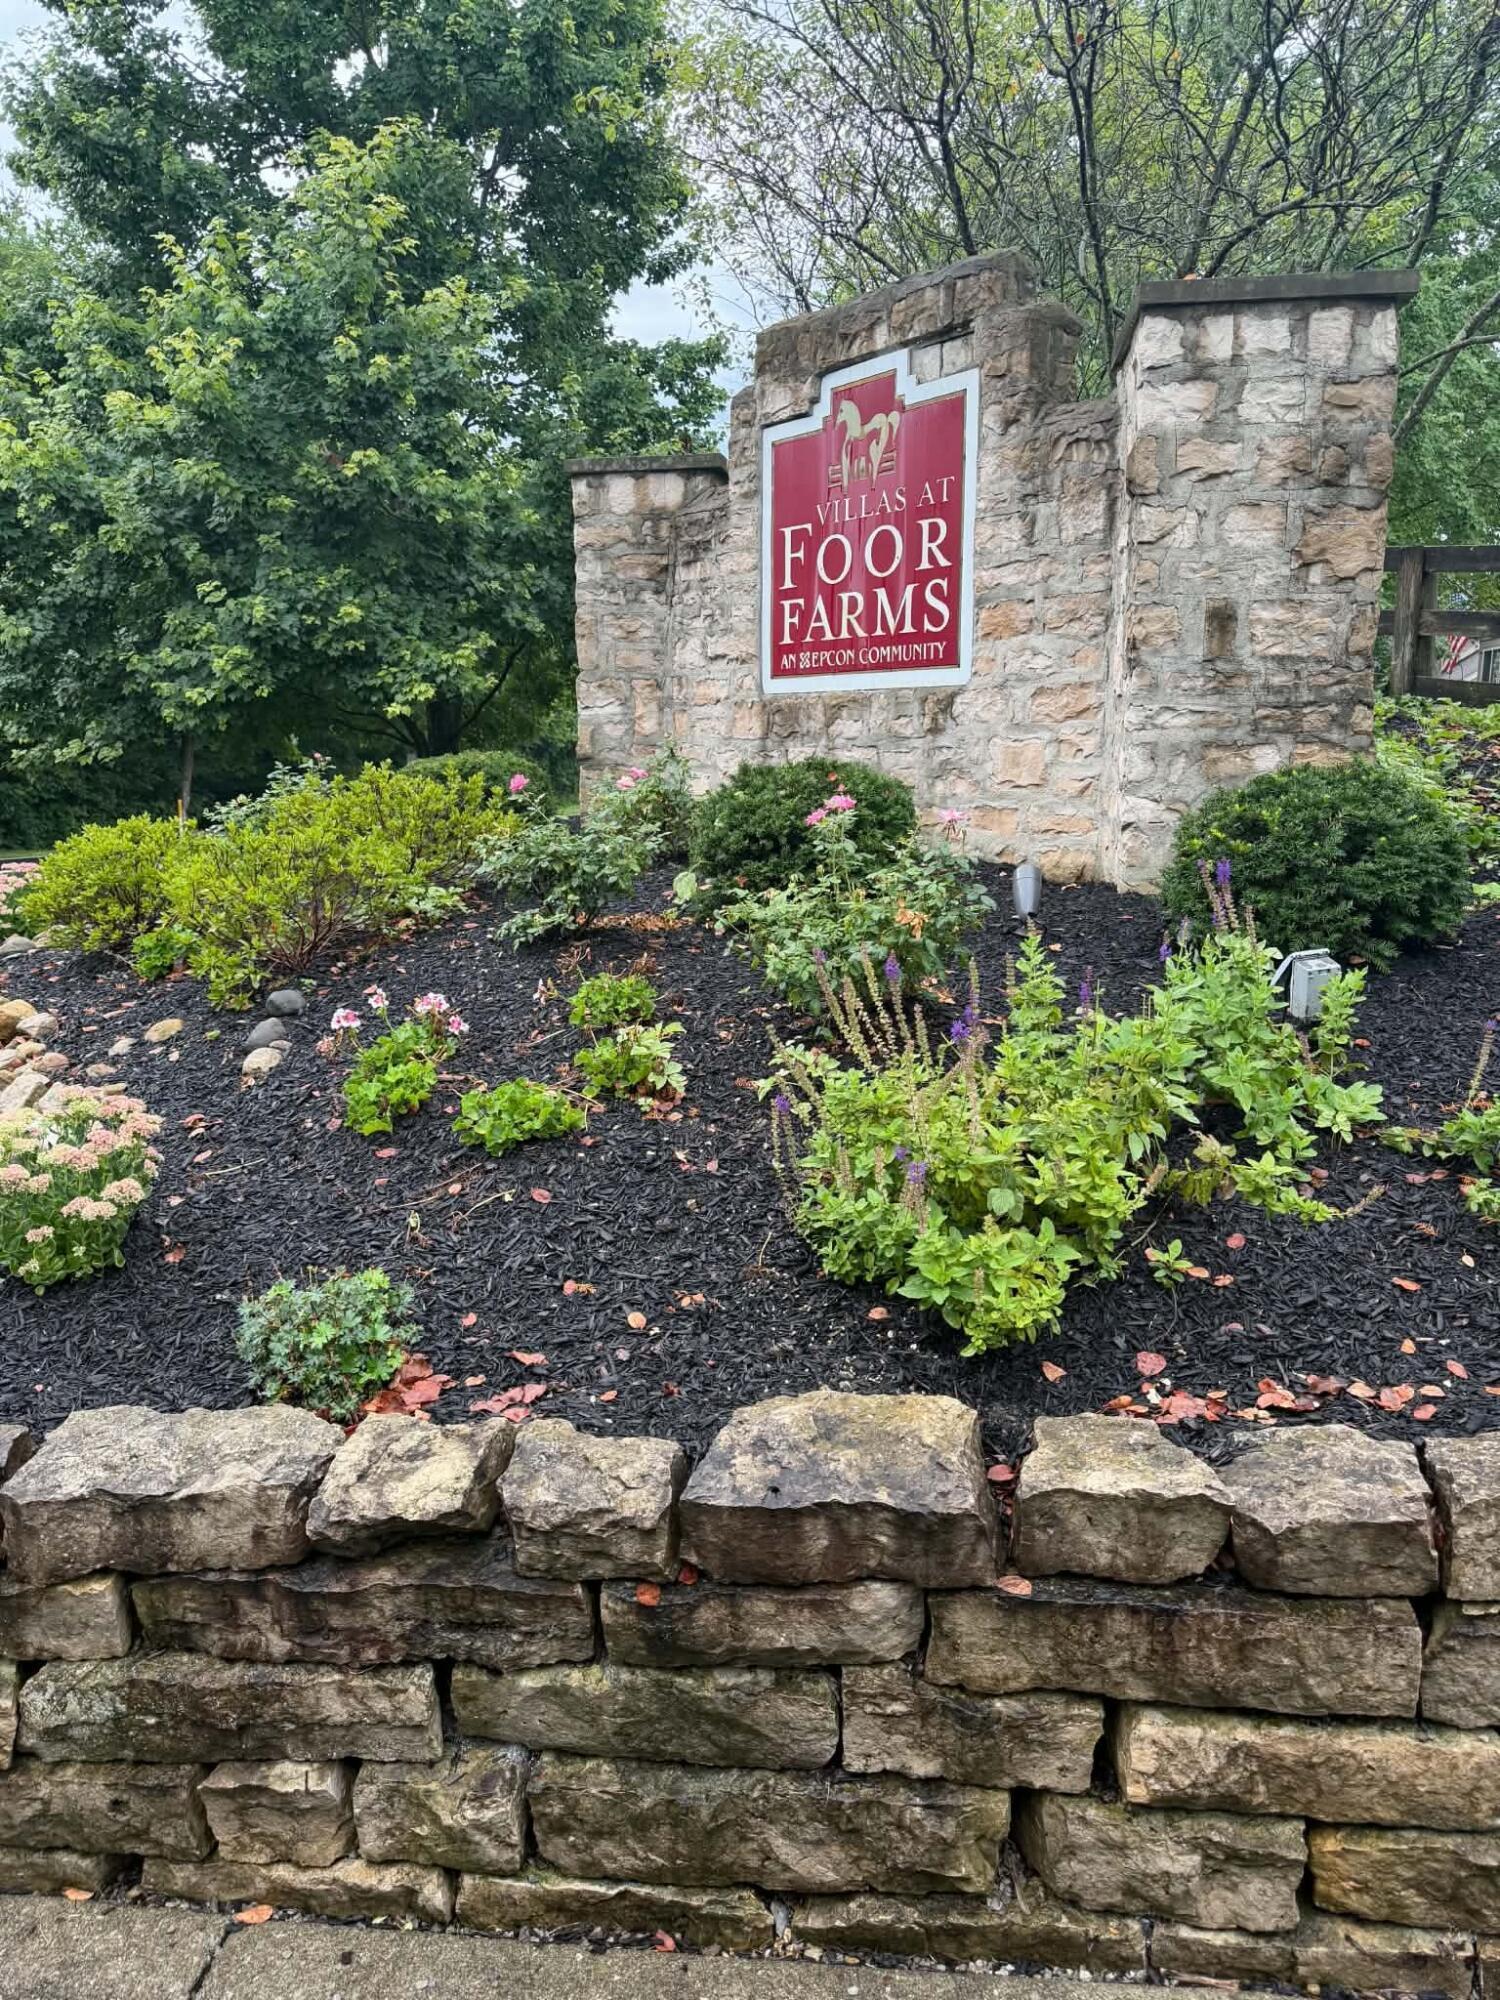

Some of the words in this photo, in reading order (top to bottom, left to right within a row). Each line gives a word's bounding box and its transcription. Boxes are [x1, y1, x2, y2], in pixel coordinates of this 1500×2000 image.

[816, 486, 906, 525] VILLAS
[916, 476, 955, 507] AT
[779, 517, 952, 590] FOOR
[779, 577, 950, 645] FARMS
[781, 653, 796, 670] AN
[811, 650, 855, 668] EPCON
[859, 641, 946, 664] COMMUNITY
